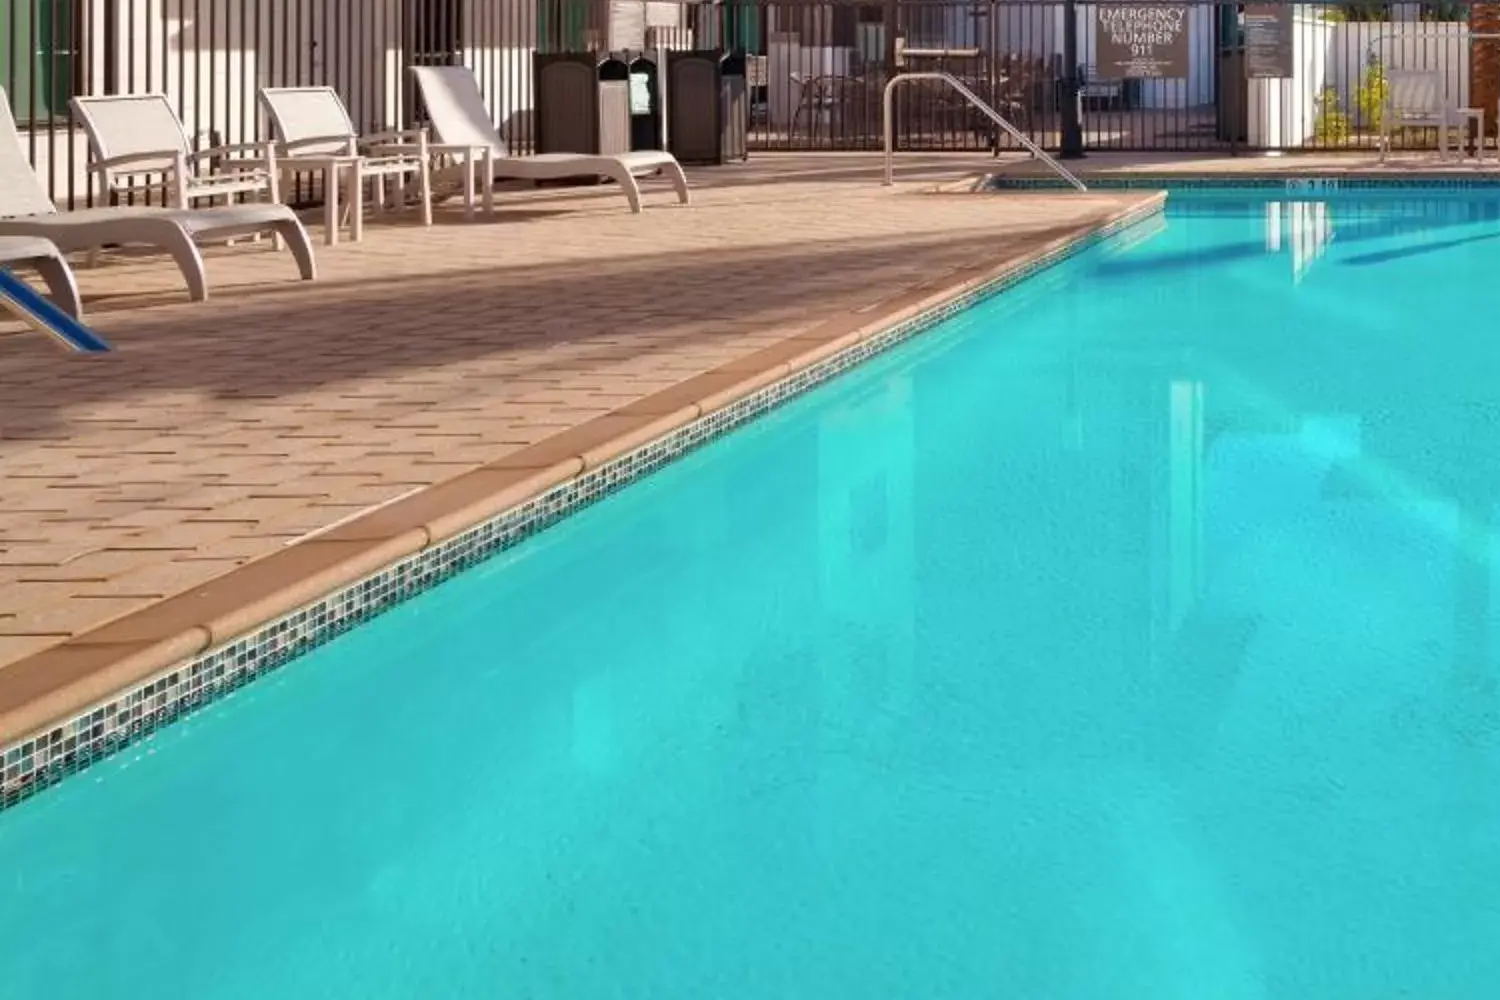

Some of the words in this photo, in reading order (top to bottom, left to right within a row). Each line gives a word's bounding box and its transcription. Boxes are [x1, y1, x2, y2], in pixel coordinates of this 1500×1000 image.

[1099, 7, 1185, 20] EMERGENCY
[1102, 20, 1182, 32] TELEPHONE
[1111, 32, 1173, 44] NUMBER
[1131, 44, 1152, 56] 911
